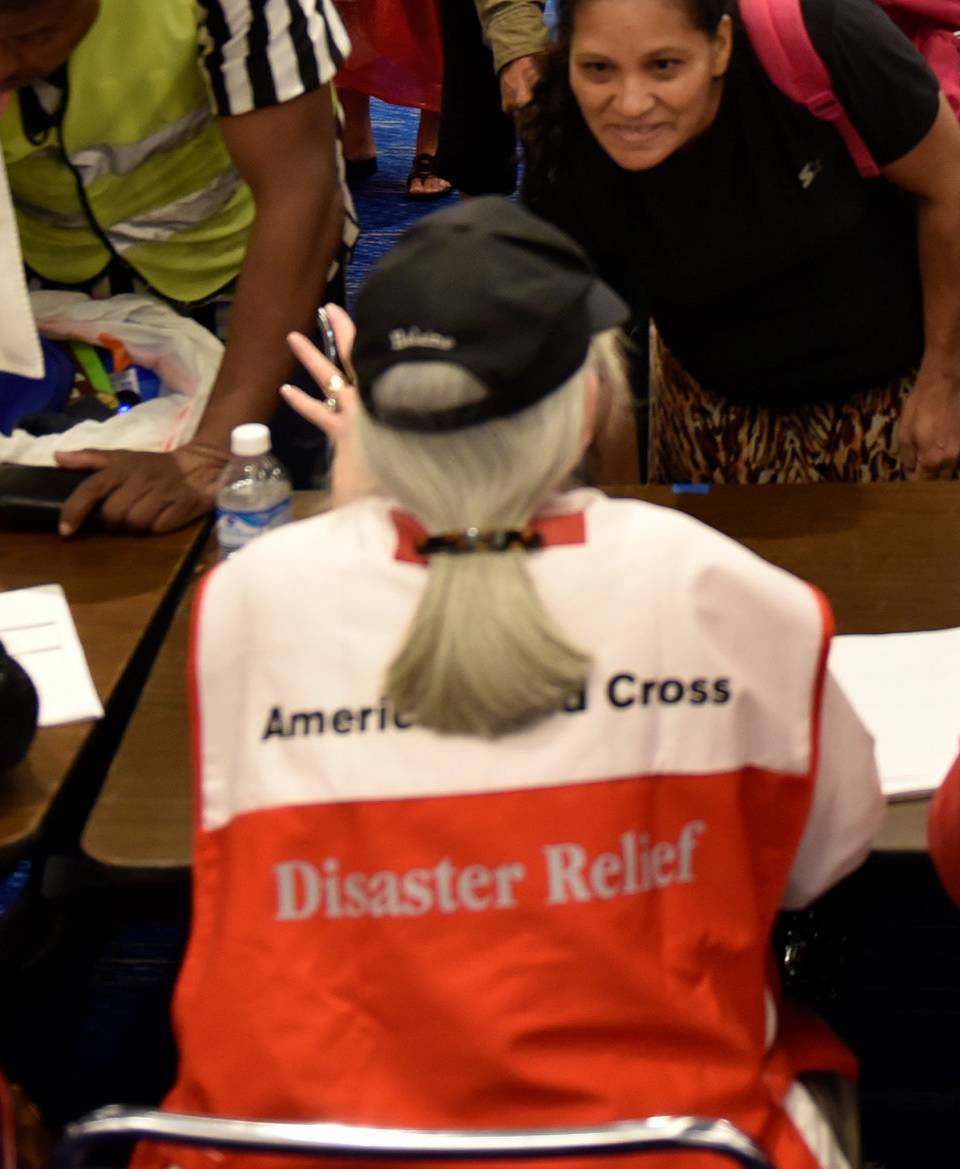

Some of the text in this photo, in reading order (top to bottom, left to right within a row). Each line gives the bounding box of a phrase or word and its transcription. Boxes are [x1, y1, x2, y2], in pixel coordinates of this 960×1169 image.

[262, 698, 414, 740] Americ
[607, 673, 731, 709] Cross
[273, 820, 706, 922] Disaster Relief
